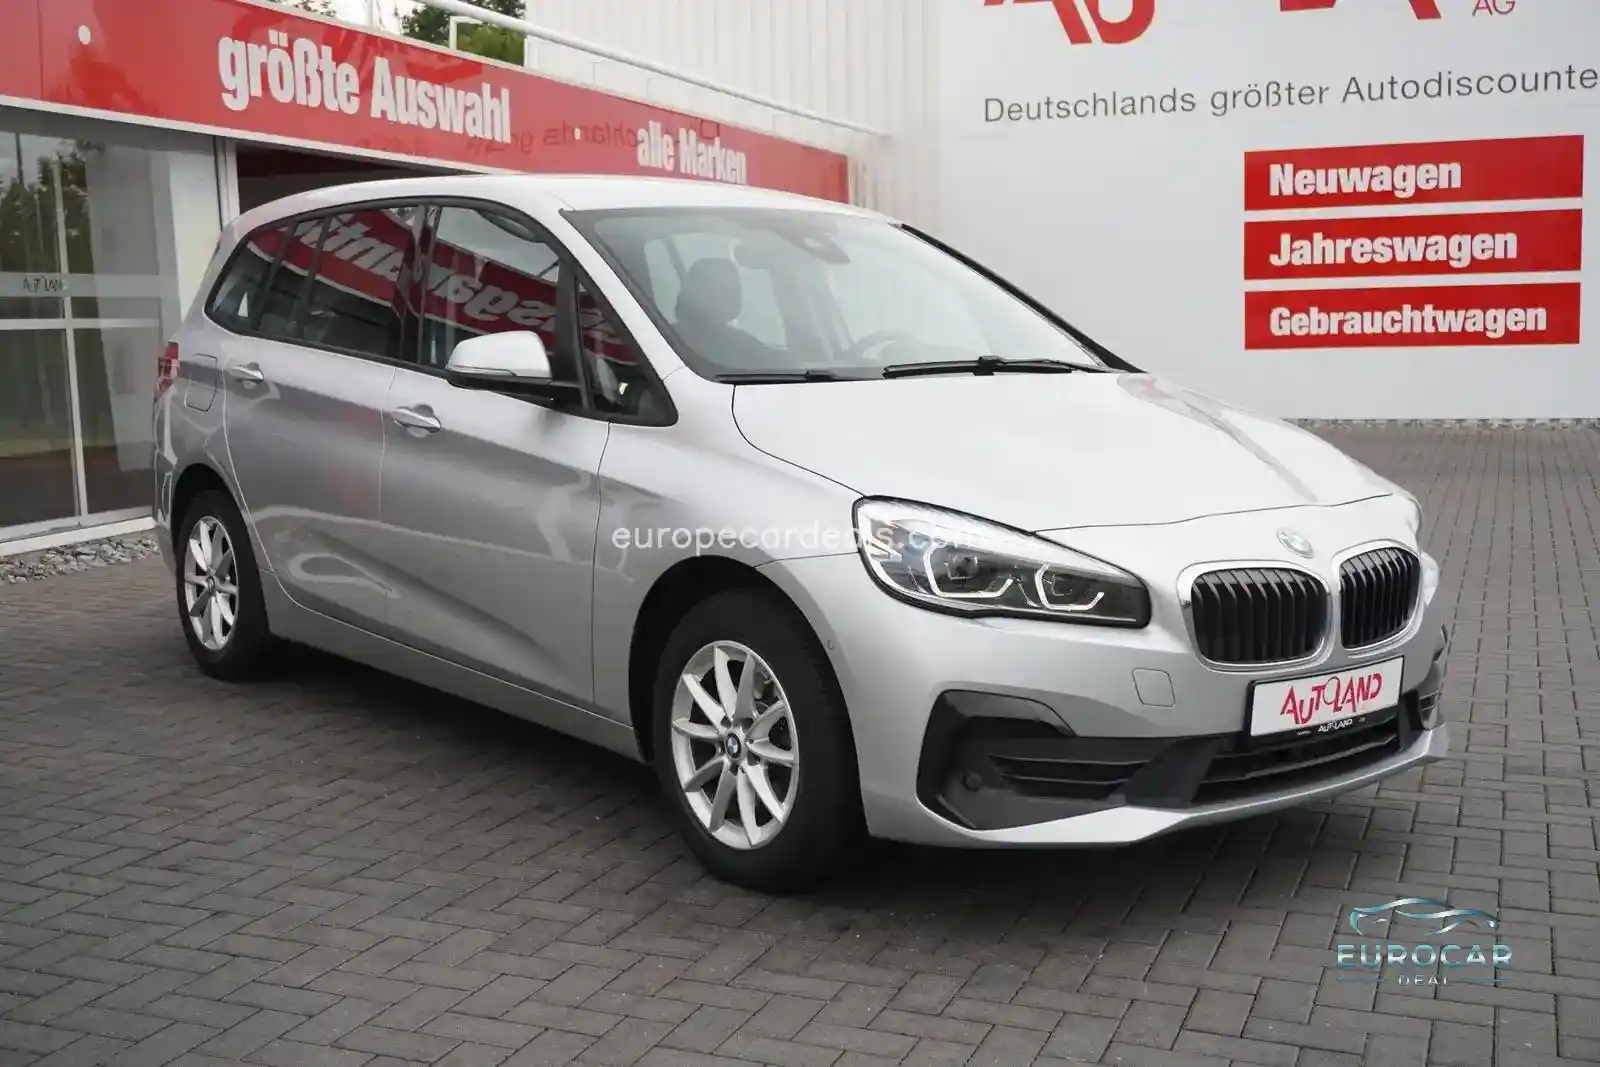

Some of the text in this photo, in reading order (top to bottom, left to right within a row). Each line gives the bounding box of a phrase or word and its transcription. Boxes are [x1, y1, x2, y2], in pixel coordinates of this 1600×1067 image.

[218, 29, 512, 144] größte Auswahl
[984, 64, 1600, 123] Deutschlands größter Autodiscounte
[636, 120, 748, 185] alle Marken
[1268, 161, 1462, 198] Neuwagen
[1268, 231, 1518, 268] Jahreswagen
[1269, 303, 1548, 339] Gebrauchtwagen
